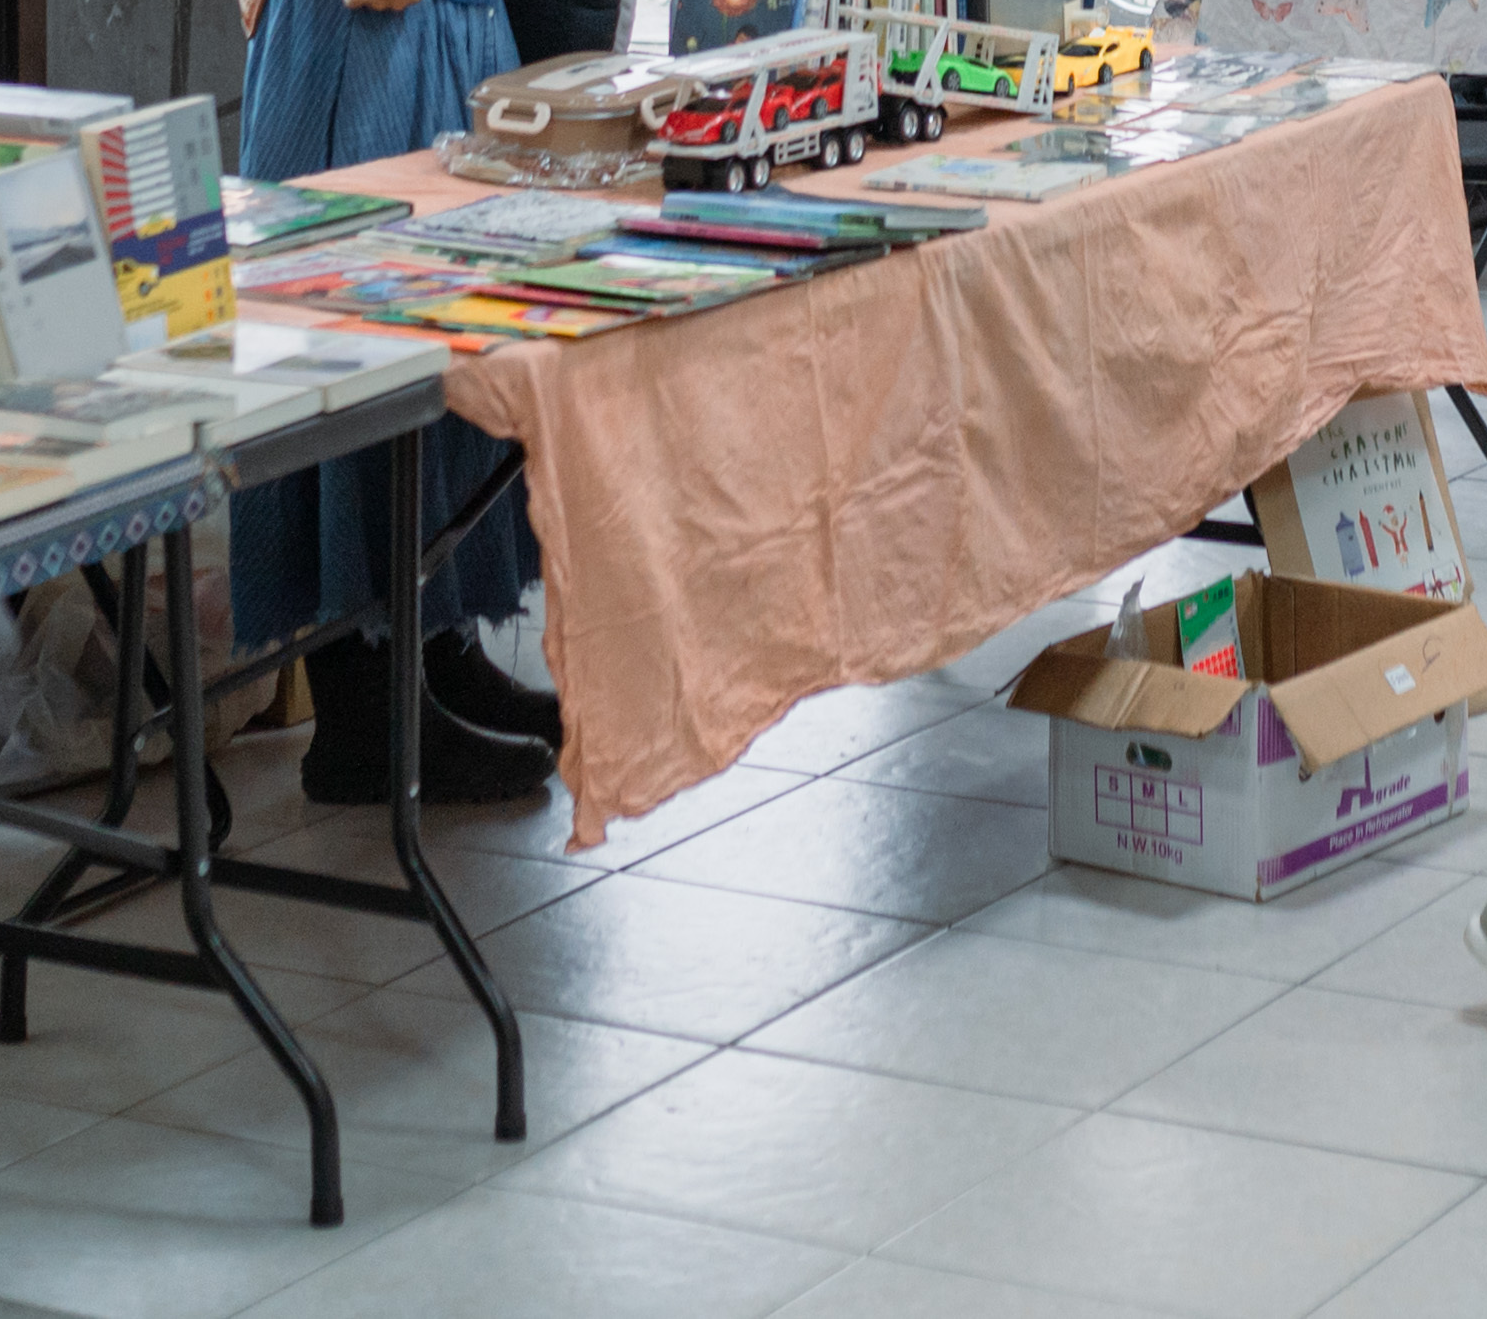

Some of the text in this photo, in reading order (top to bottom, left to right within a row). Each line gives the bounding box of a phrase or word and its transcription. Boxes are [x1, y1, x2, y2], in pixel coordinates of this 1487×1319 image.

[1142, 782, 1155, 799] M
[1178, 789, 1188, 807] L
[1375, 774, 1411, 804] grade
[1329, 830, 1354, 852] Place
